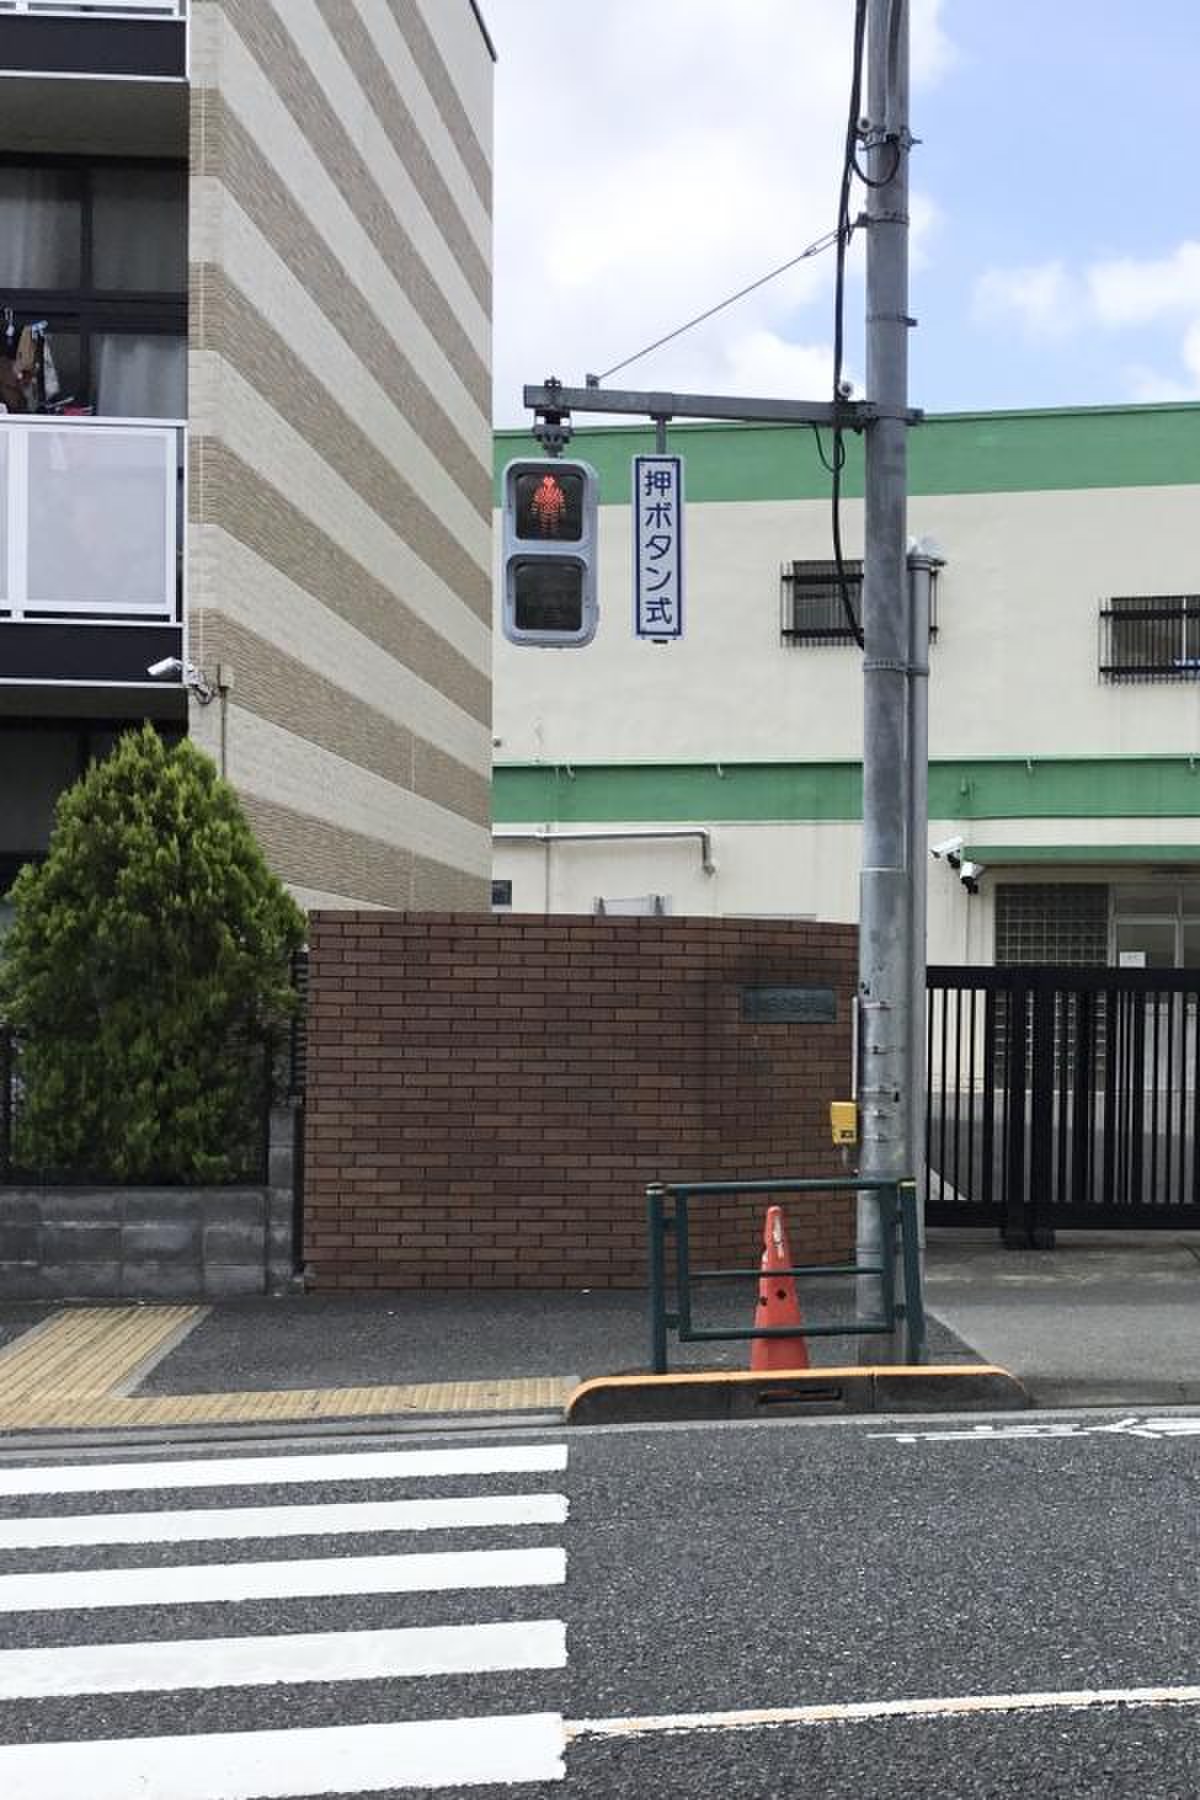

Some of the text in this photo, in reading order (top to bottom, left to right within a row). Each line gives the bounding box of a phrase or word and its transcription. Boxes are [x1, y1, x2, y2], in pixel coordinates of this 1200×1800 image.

[644, 470, 672, 624] 押ボタン式
